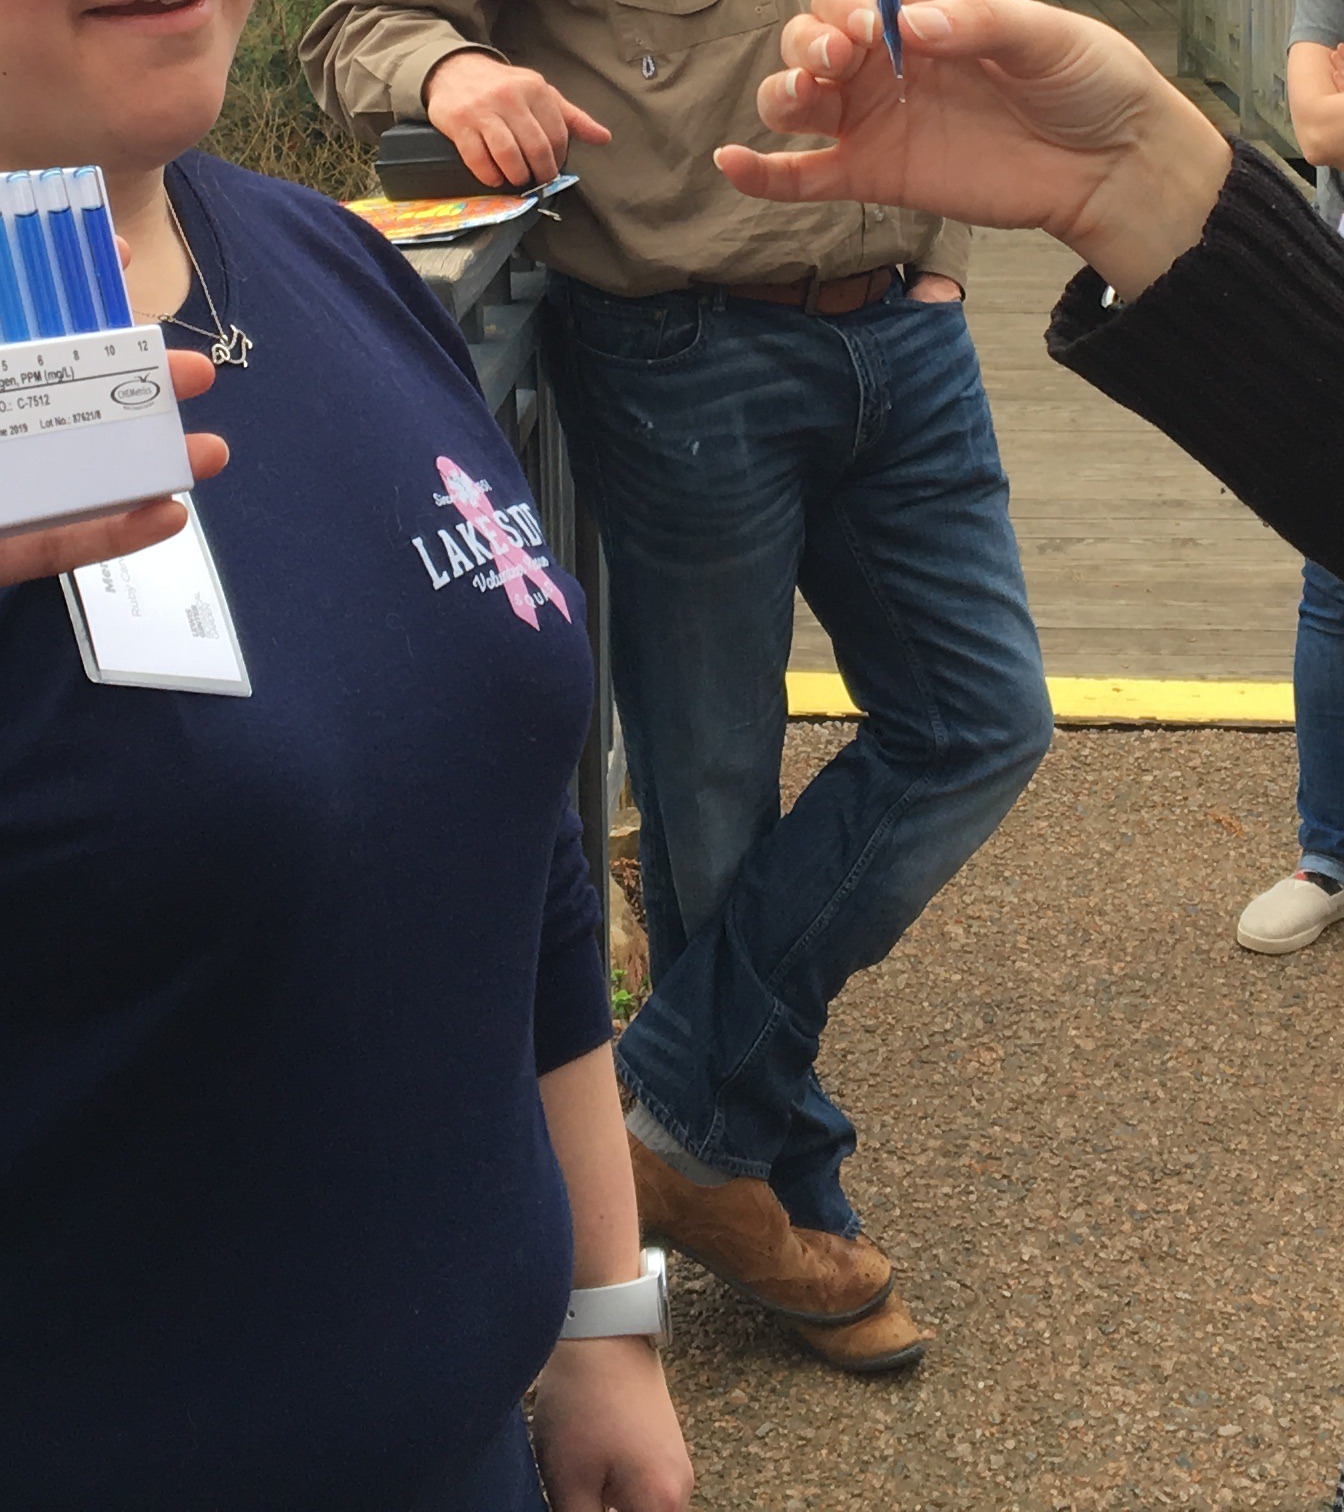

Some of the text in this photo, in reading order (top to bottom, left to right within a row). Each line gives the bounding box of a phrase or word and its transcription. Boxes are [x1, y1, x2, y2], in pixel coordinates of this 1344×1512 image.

[1, 360, 8, 372] 5
[37, 354, 44, 367] 6
[72, 349, 80, 361] 8
[104, 344, 116, 357] 10
[137, 340, 149, 352] 12
[20, 370, 42, 384] PPM
[44, 366, 75, 384] (mg/L)
[16, 394, 50, 410] C-7512
[9, 423, 28, 436] 2019
[39, 418, 54, 429] Lot
[126, 584, 142, 617] Ruby
